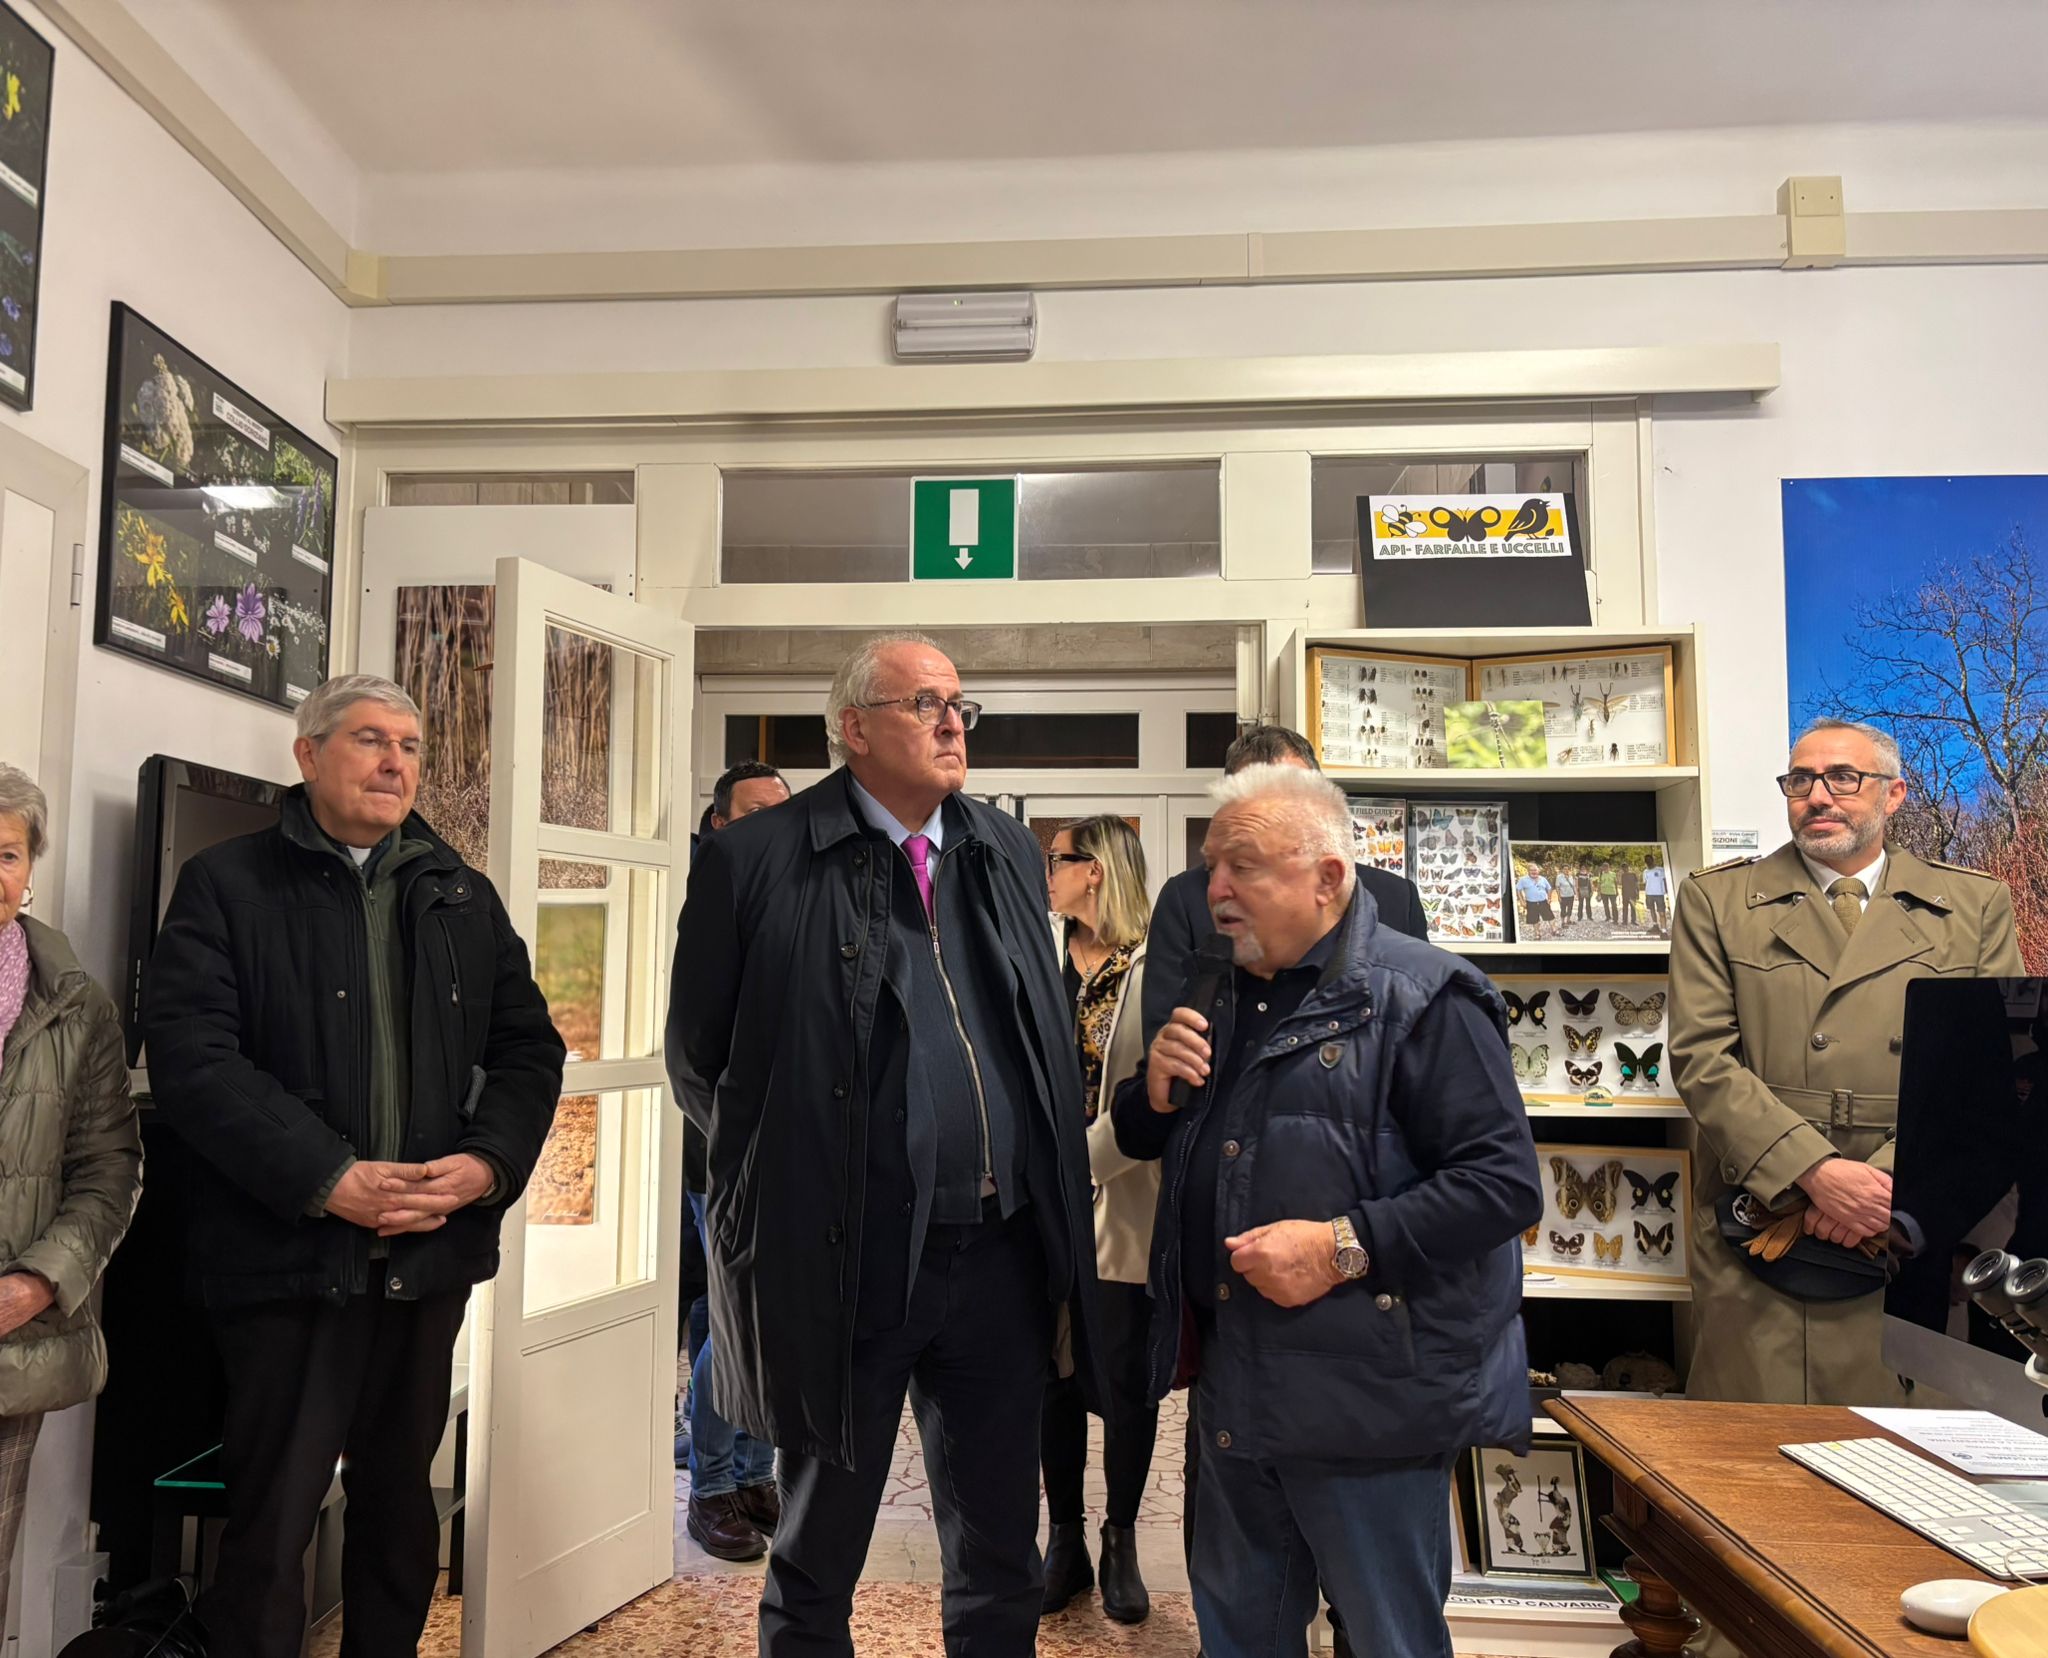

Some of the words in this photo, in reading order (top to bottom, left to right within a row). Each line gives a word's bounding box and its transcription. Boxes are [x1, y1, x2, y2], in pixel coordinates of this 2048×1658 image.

[1379, 544, 1412, 556] API-
[1415, 543, 1484, 555] FARFALLE
[1490, 543, 1499, 554] E
[1502, 542, 1564, 554] UCCELLI
[1447, 1596, 1520, 1605] OGETTO
[1525, 1601, 1610, 1609] CALVARIO
